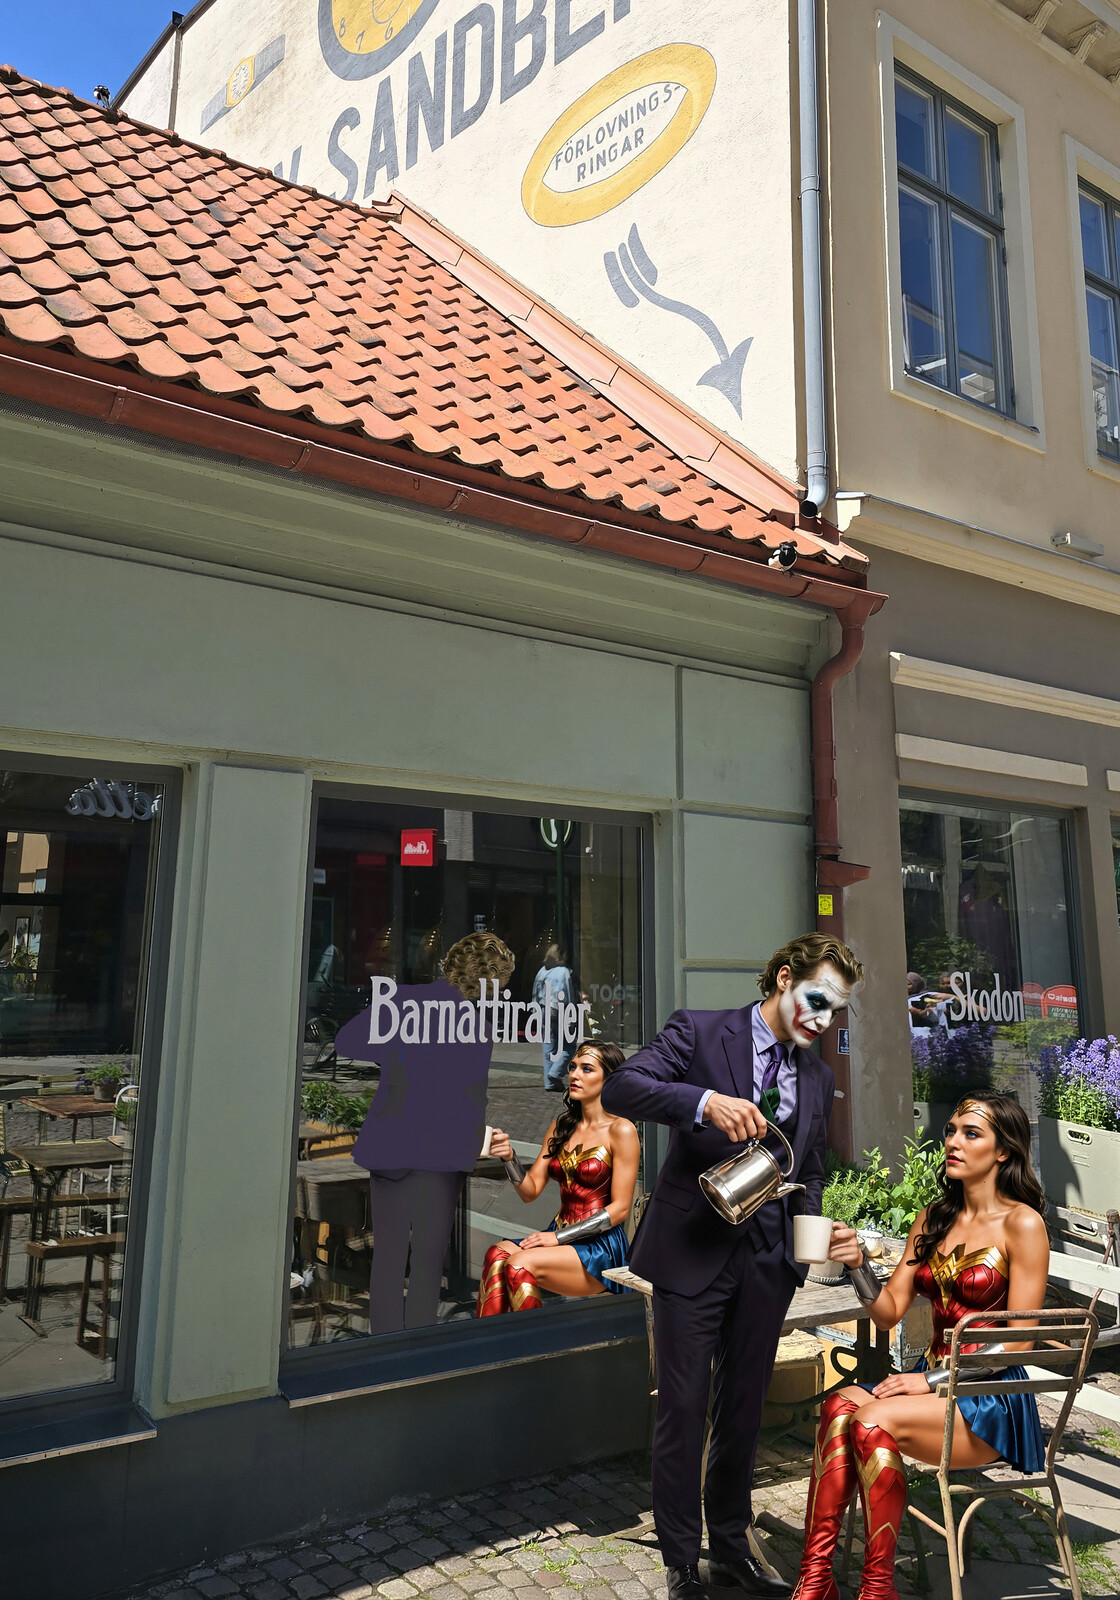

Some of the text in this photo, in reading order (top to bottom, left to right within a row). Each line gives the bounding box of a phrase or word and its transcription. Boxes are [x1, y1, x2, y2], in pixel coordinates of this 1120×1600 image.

[327, 0, 631, 203] SANDB
[554, 83, 681, 171] FÖRLOVNINGS-
[577, 127, 644, 182] RINGAR
[367, 975, 591, 1062] Barnattiraljer
[949, 971, 1026, 1022] Skodon
